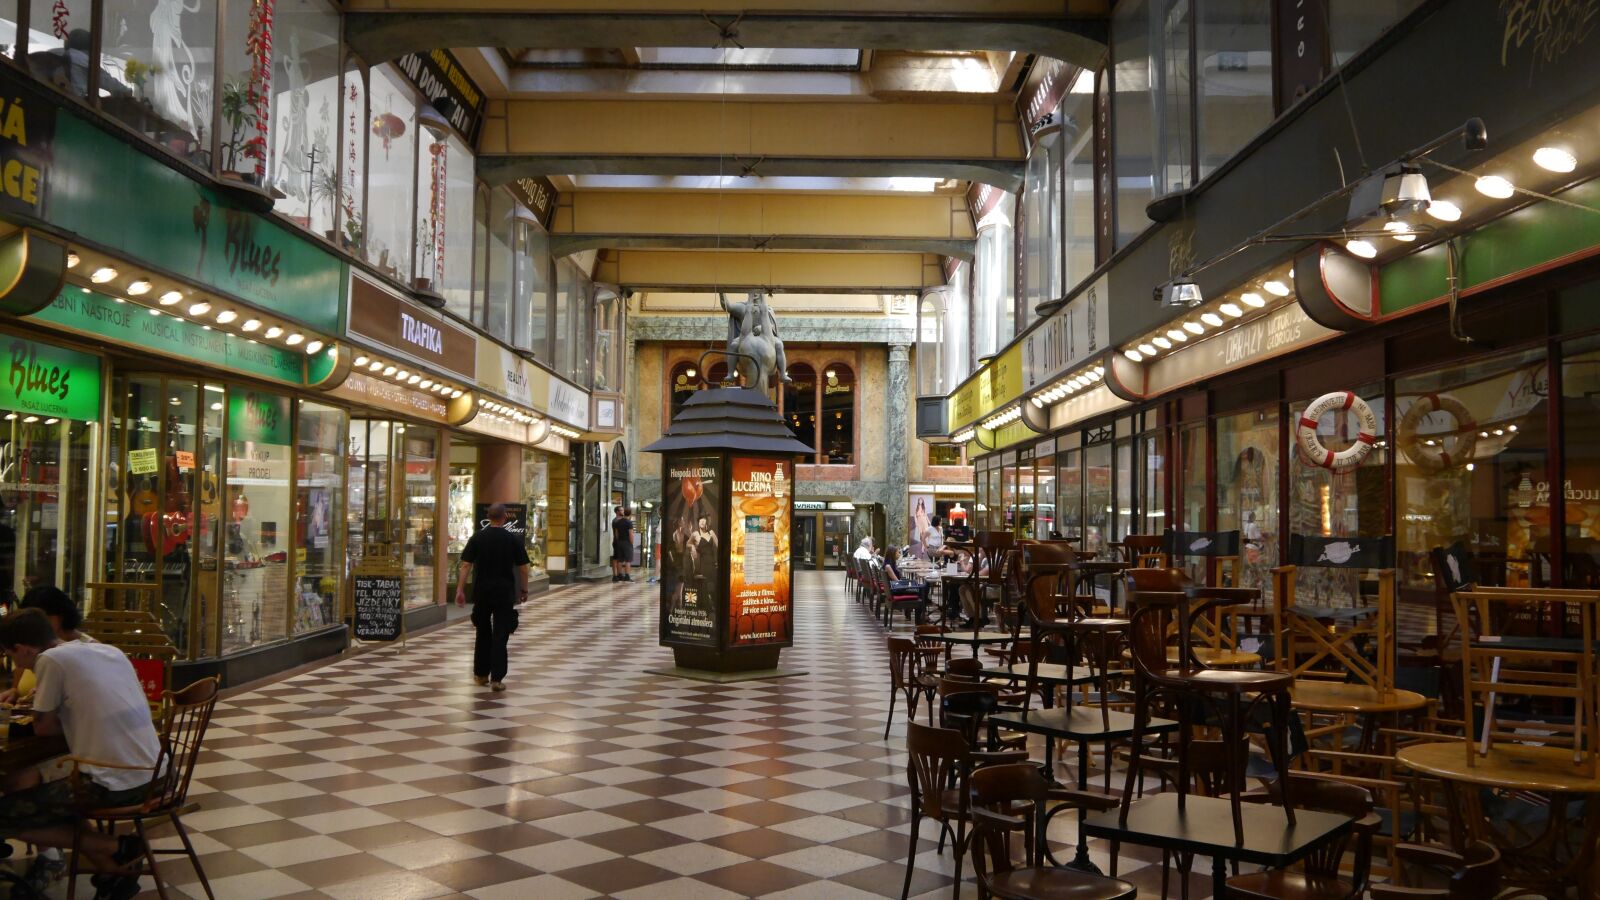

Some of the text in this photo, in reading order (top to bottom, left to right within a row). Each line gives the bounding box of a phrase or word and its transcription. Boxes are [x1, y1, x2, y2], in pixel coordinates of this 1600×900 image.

[0, 96, 28, 147] Á
[0, 159, 41, 206] CE
[224, 207, 282, 288] Blues
[142, 319, 180, 343] MUSICAL
[401, 312, 443, 355] TRAFIKA
[1043, 308, 1075, 376] AMFORA
[1225, 320, 1265, 366] OBRAZY
[1266, 325, 1301, 350] GLORIOUS
[8, 338, 71, 400] Blues
[691, 466, 716, 479] LUCERNA
[732, 480, 773, 493] LUCERNA
[751, 471, 772, 483] KINO
[740, 631, 777, 640] www.lucerna.cz
